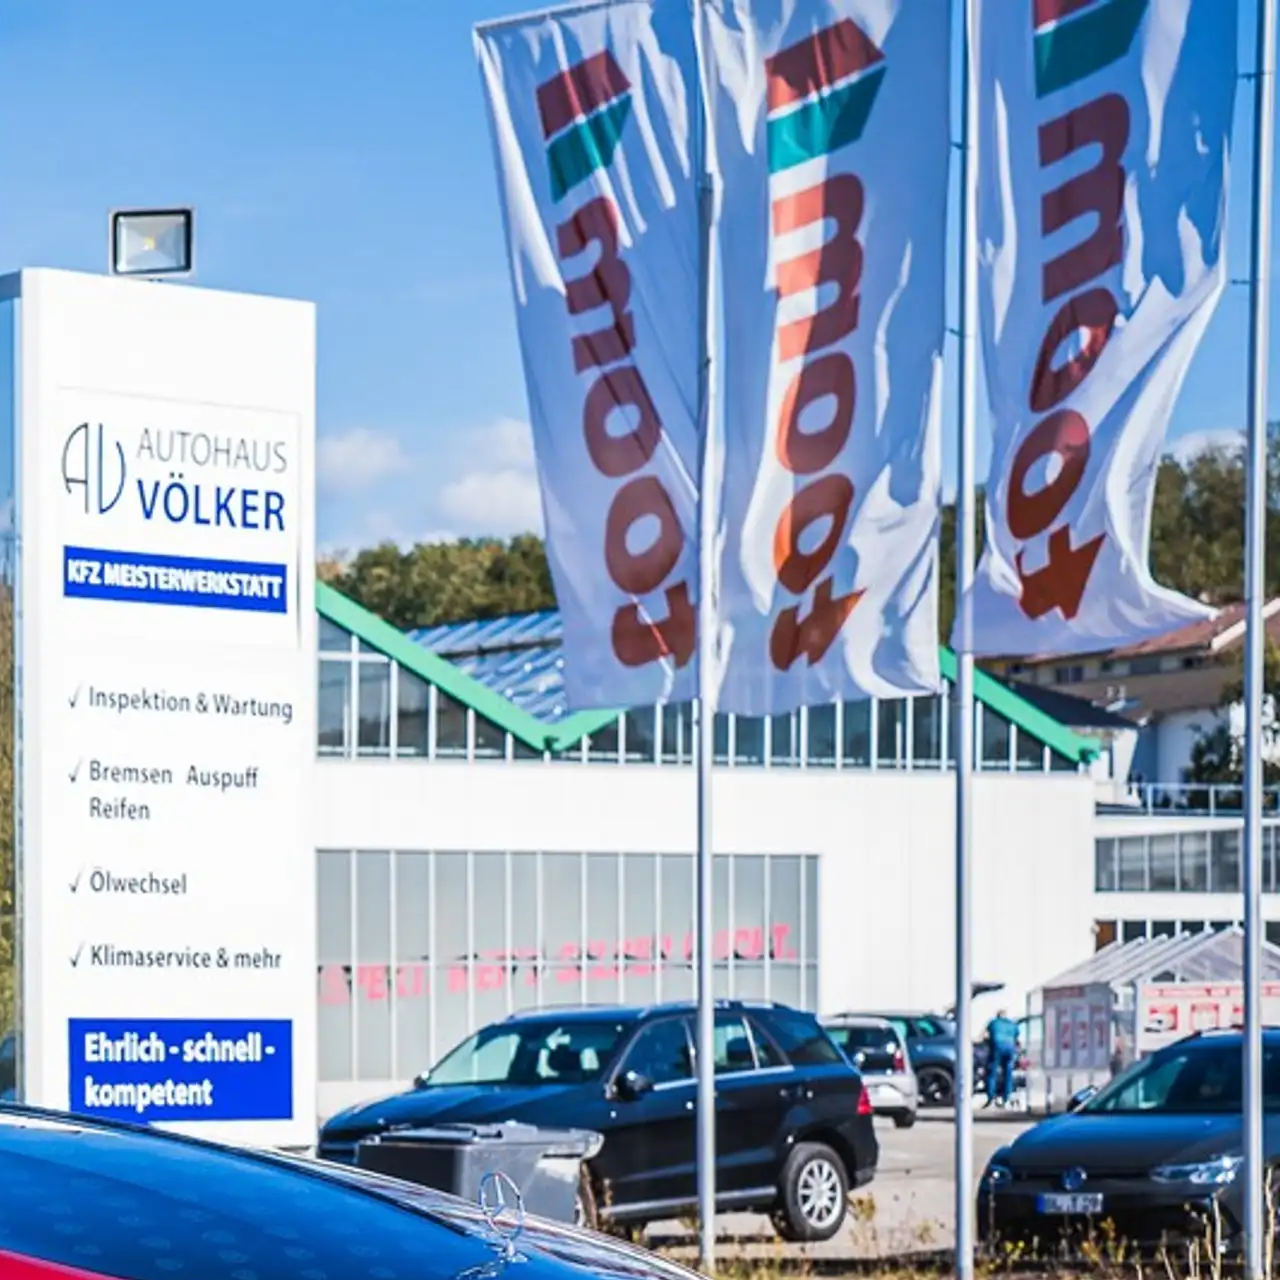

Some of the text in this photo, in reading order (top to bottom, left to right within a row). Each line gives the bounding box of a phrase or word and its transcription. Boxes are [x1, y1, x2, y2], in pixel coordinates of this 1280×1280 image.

[1007, 93, 1130, 620] toom
[555, 195, 696, 668] toom
[770, 172, 867, 671] toom
[136, 428, 288, 473] AUTOHAUS
[137, 472, 285, 531] VÖLKER
[67, 558, 283, 598] KFZ MEISTERWERKSTATT
[89, 686, 293, 725] Inspektion & Wartung
[89, 759, 258, 793] Bremsen Auspuff
[89, 796, 150, 820] Reifen
[89, 866, 187, 895] Ölwechsel
[91, 944, 281, 969] Klimaservice & mehr
[84, 1031, 165, 1062] Ehrlich
[183, 1031, 262, 1063] schnell
[84, 1075, 213, 1114] kompetent
